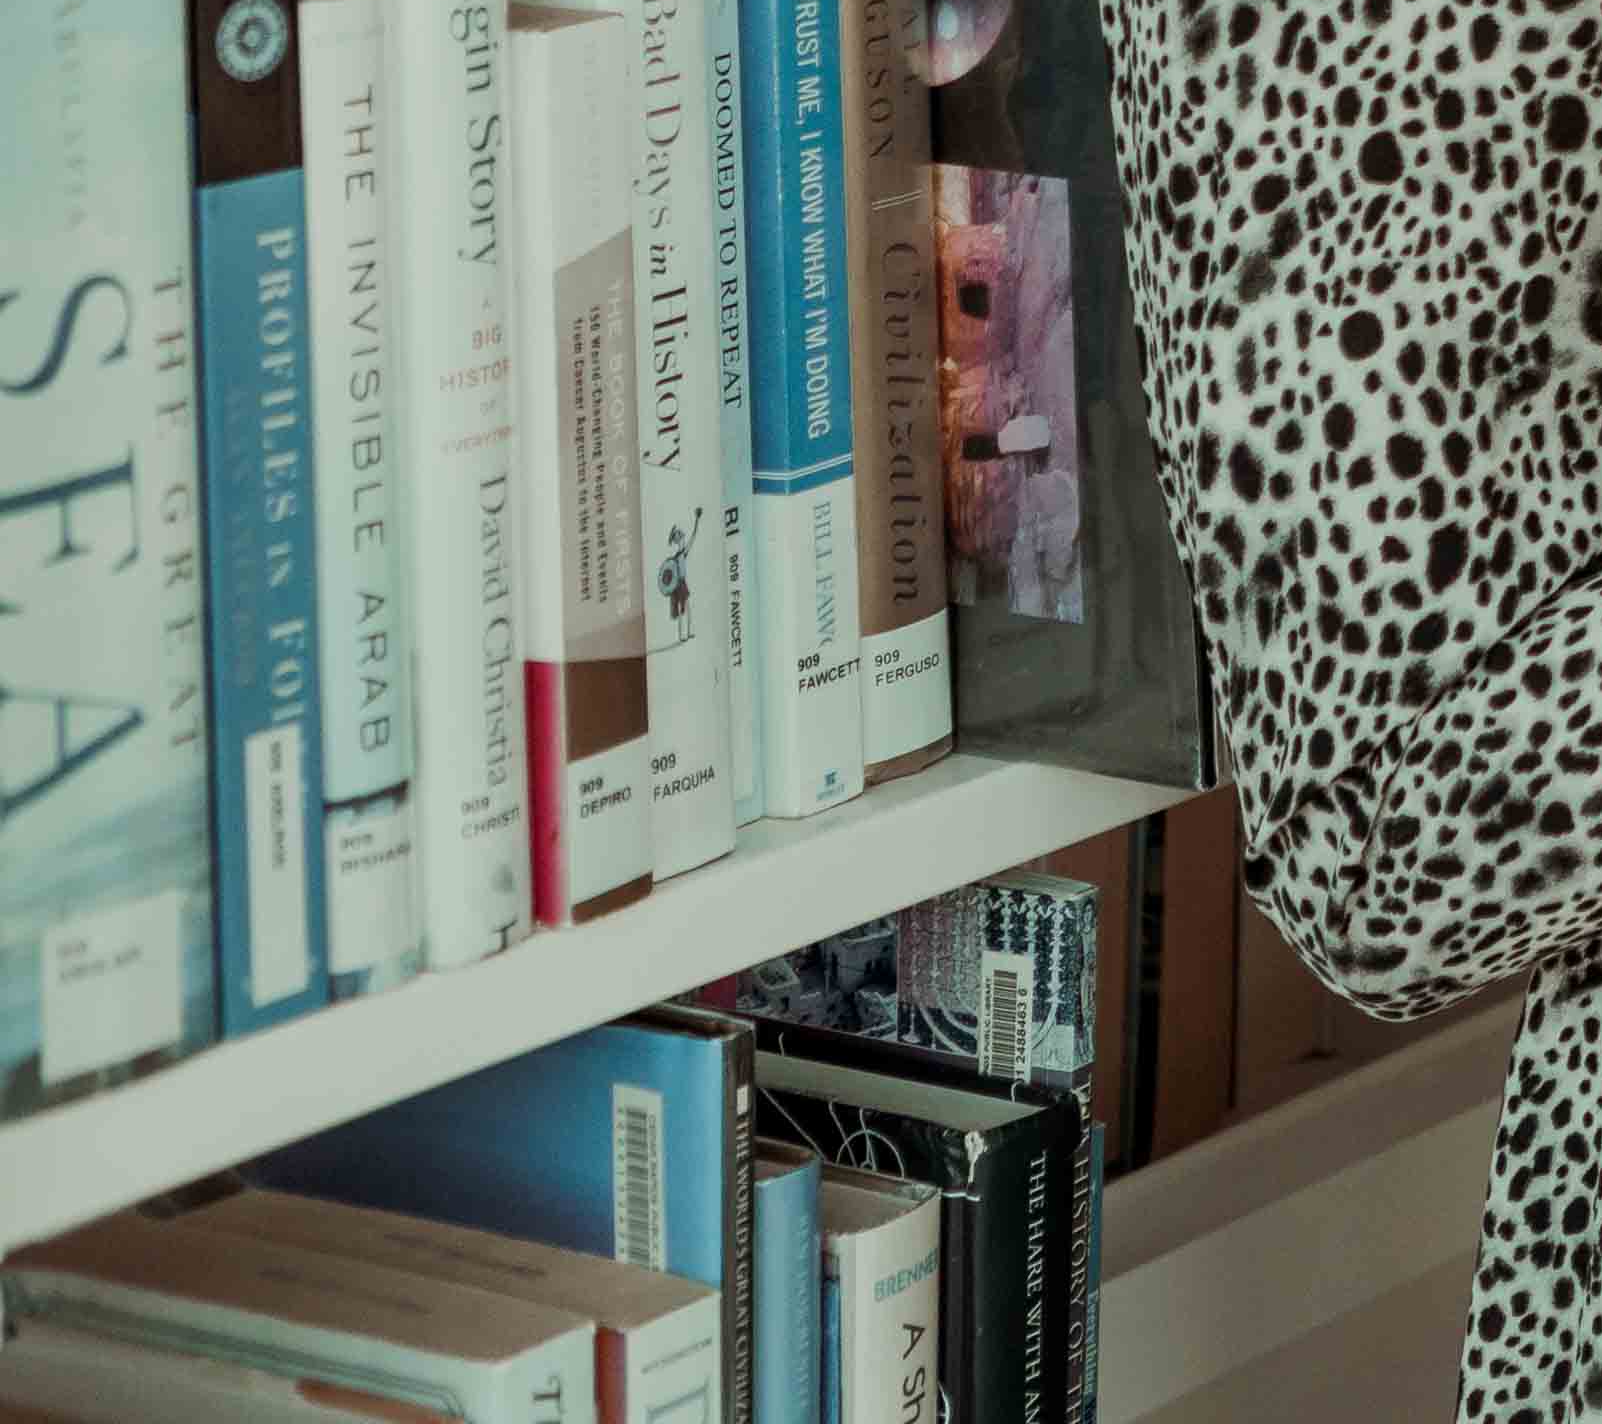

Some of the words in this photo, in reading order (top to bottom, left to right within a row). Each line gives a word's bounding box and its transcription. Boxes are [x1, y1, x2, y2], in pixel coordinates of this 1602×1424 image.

[713, 51, 737, 211] DOOMED
[796, 75, 822, 126] ME,
[343, 83, 376, 201] THE
[632, 104, 684, 233] Days
[457, 112, 504, 267] Story
[799, 144, 827, 228] KNOW
[648, 244, 670, 280] in
[717, 219, 738, 265] TO
[801, 229, 829, 303] WHAT
[720, 278, 744, 412] REPEAT
[804, 307, 830, 352] I'M
[255, 225, 299, 524] PROFILES
[348, 238, 387, 553] INVISIBLE
[642, 282, 691, 474] History
[806, 355, 834, 442] DOING
[881, 242, 926, 603] Civilization
[158, 481, 201, 756] GREAT
[730, 588, 744, 669] FAWCETT
[353, 588, 391, 754] ARAB
[797, 652, 822, 672] 909
[798, 658, 862, 692] FAWCETT
[875, 648, 901, 669] 909
[875, 654, 942, 688] FERGUSO
[579, 776, 605, 796] 909
[651, 753, 677, 774] 909
[653, 764, 717, 803] FARQUHA
[579, 786, 633, 819] DEPIRO
[735, 1117, 751, 1162] THE
[1029, 1150, 1049, 1209] THE
[1026, 1214, 1048, 1294] HARE
[1067, 1158, 1091, 1308] HISTORY
[734, 1257, 752, 1330] GREAT
[902, 1322, 926, 1361] A
[1024, 1298, 1045, 1376] WITH
[1066, 1320, 1088, 1365] OF
